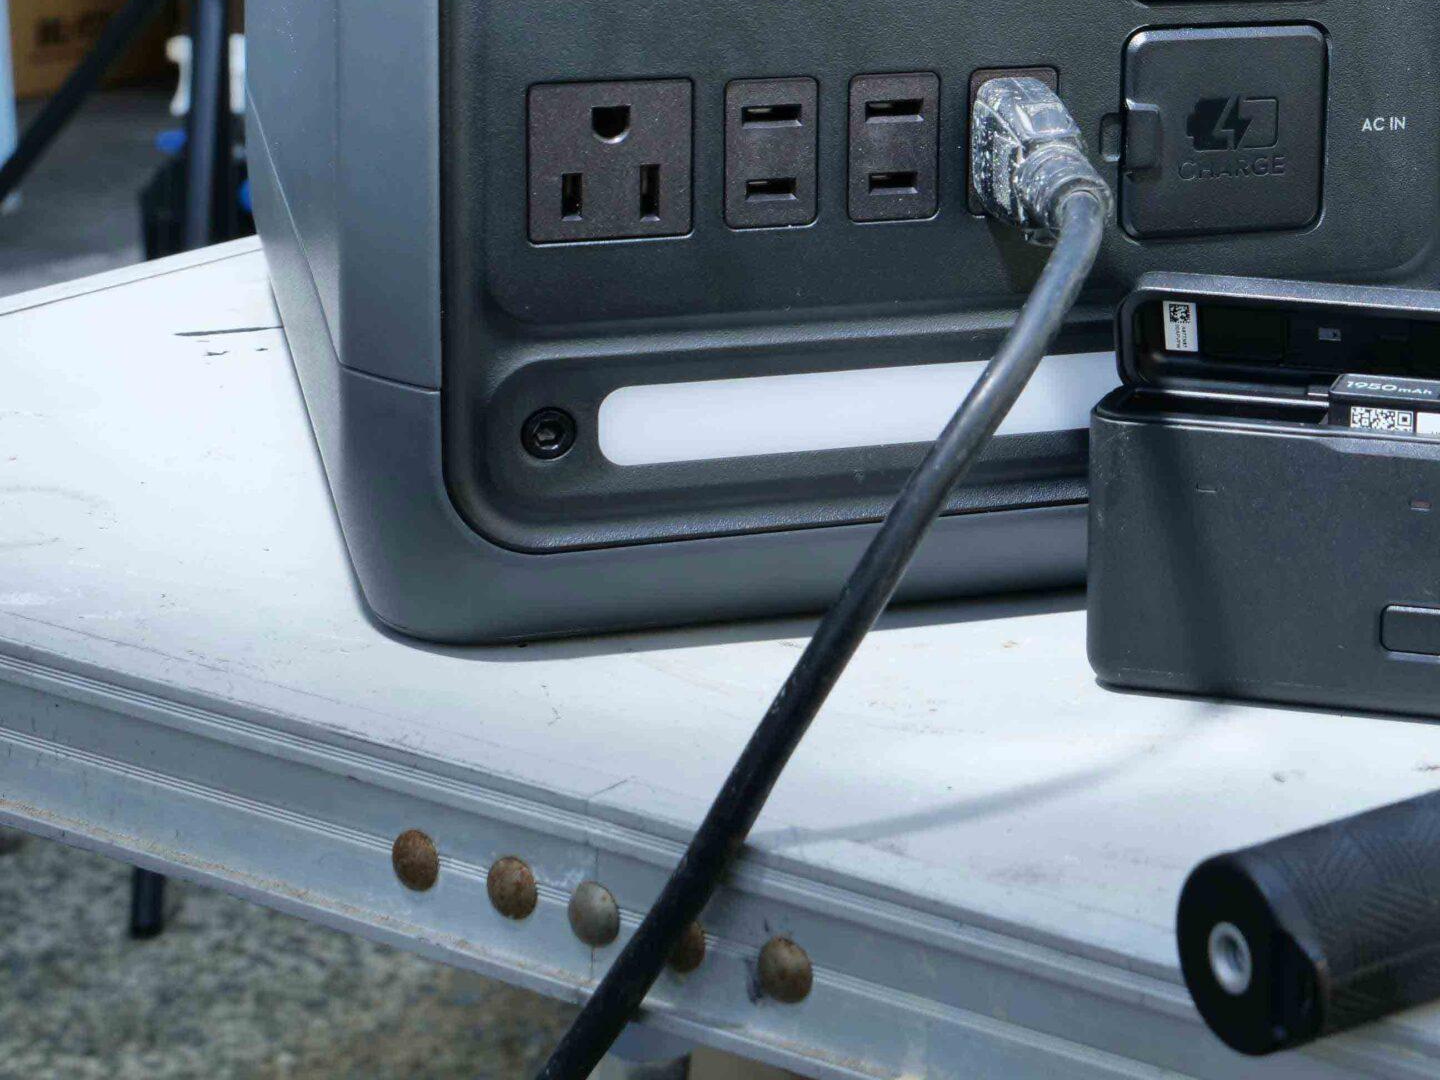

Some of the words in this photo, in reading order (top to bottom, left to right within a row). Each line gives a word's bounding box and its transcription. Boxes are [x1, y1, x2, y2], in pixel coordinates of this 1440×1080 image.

[1361, 117, 1385, 132] AC
[1389, 116, 1406, 131] IN
[1178, 157, 1286, 181] CHARGE
